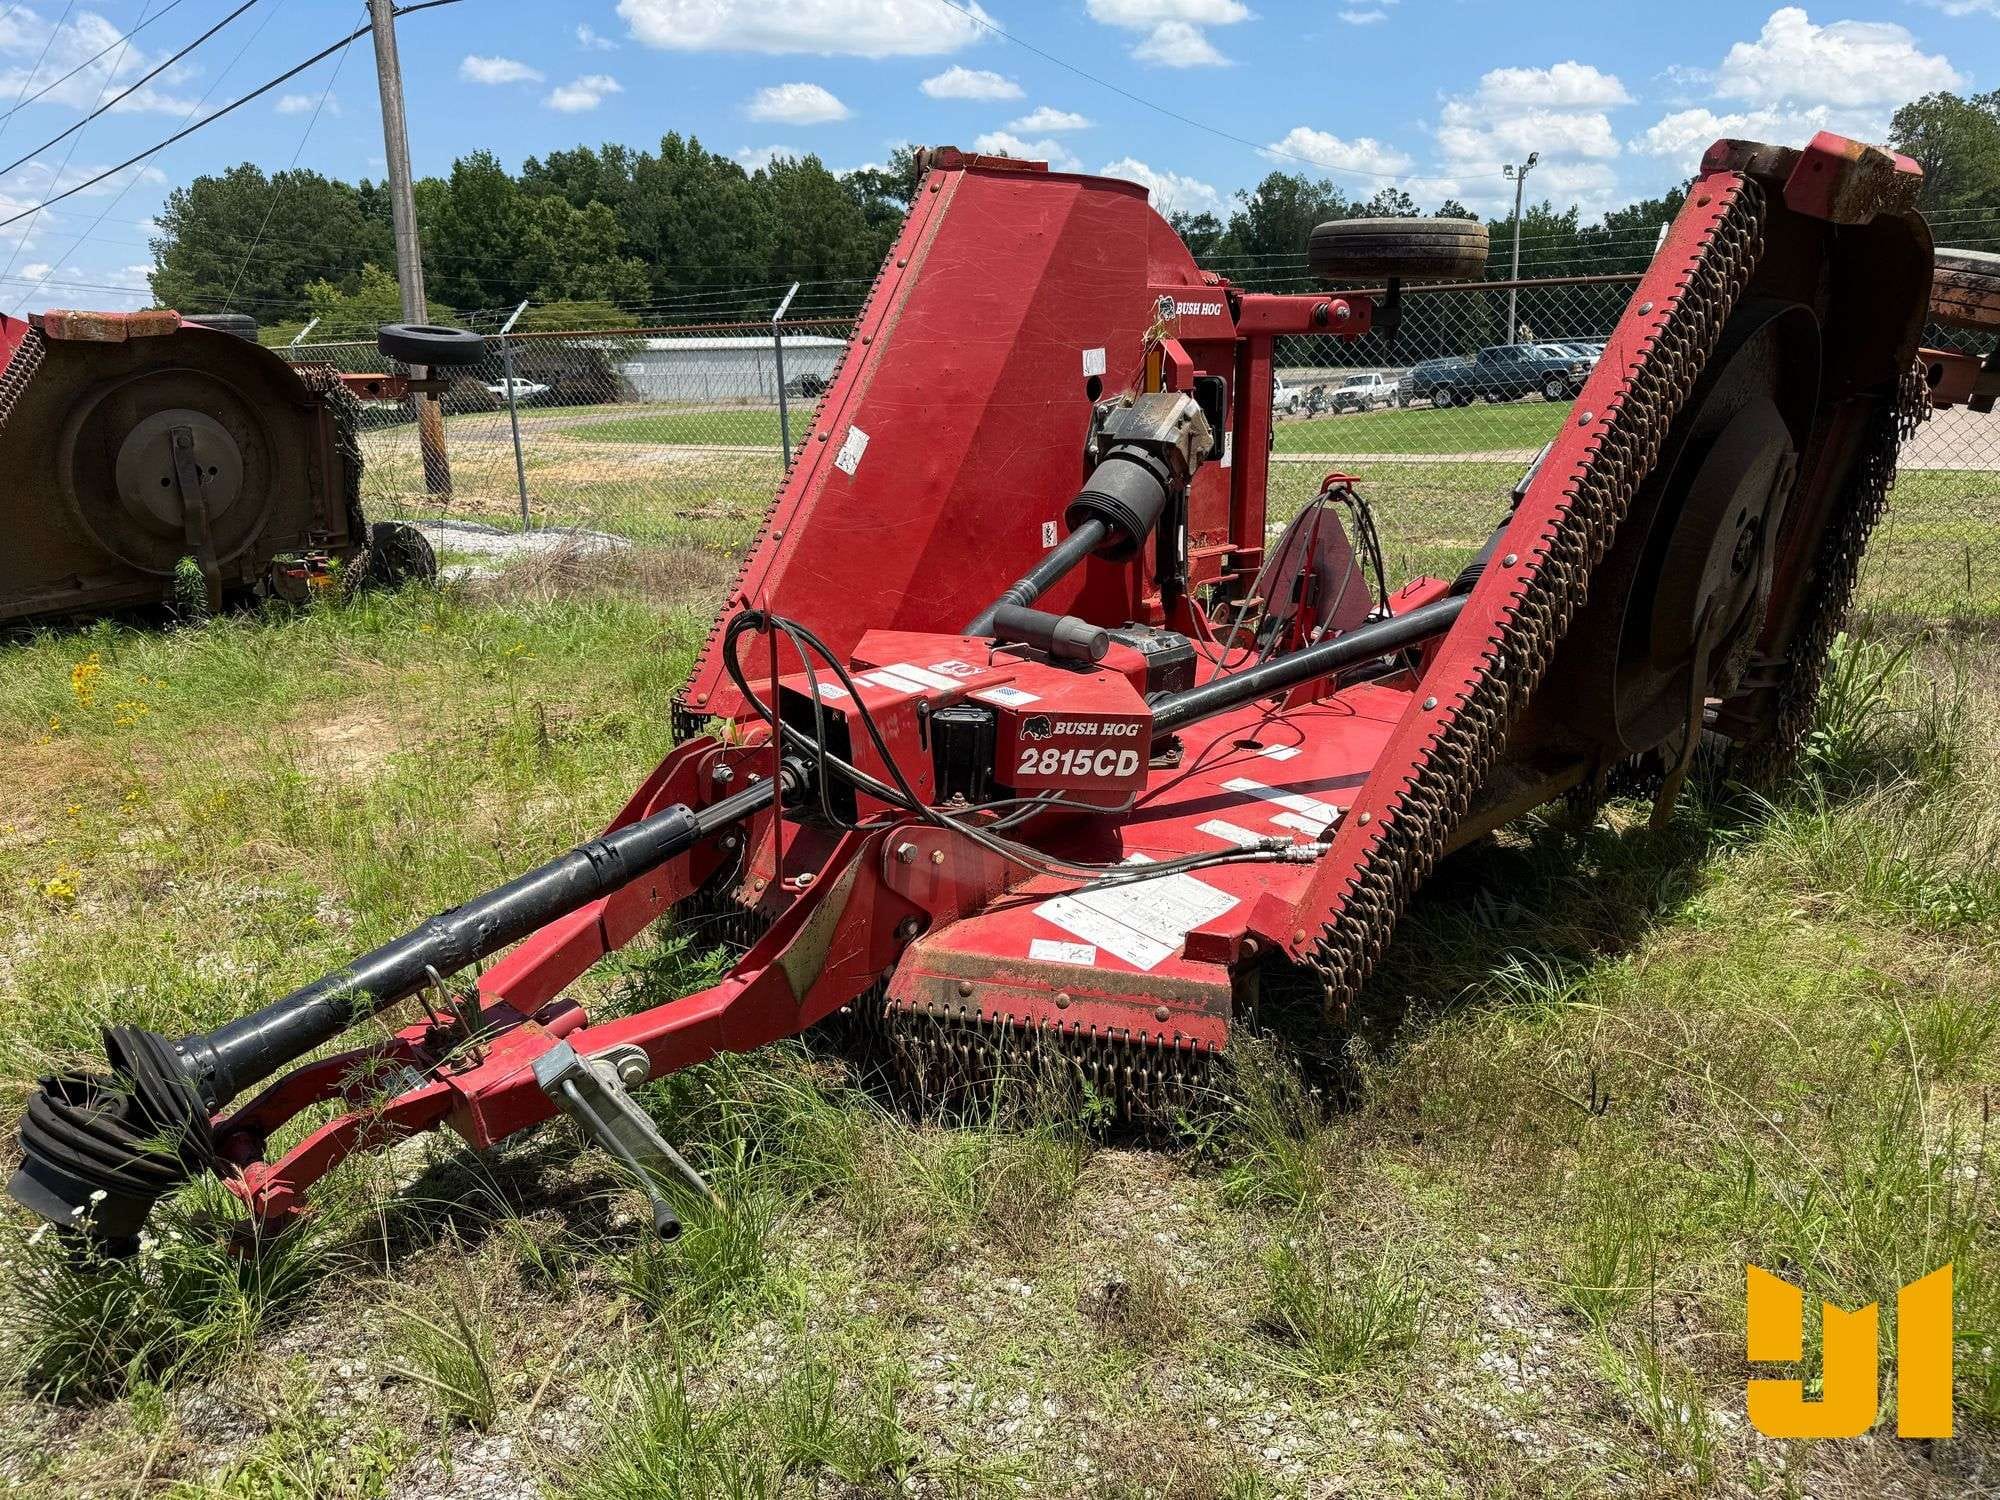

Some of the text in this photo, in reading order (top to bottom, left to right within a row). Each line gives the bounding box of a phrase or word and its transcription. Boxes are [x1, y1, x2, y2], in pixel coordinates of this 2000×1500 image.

[1176, 302, 1221, 316] BUSH HOG
[1053, 722, 1139, 737] BUSH HOG
[1017, 748, 1139, 777] 2815CD
